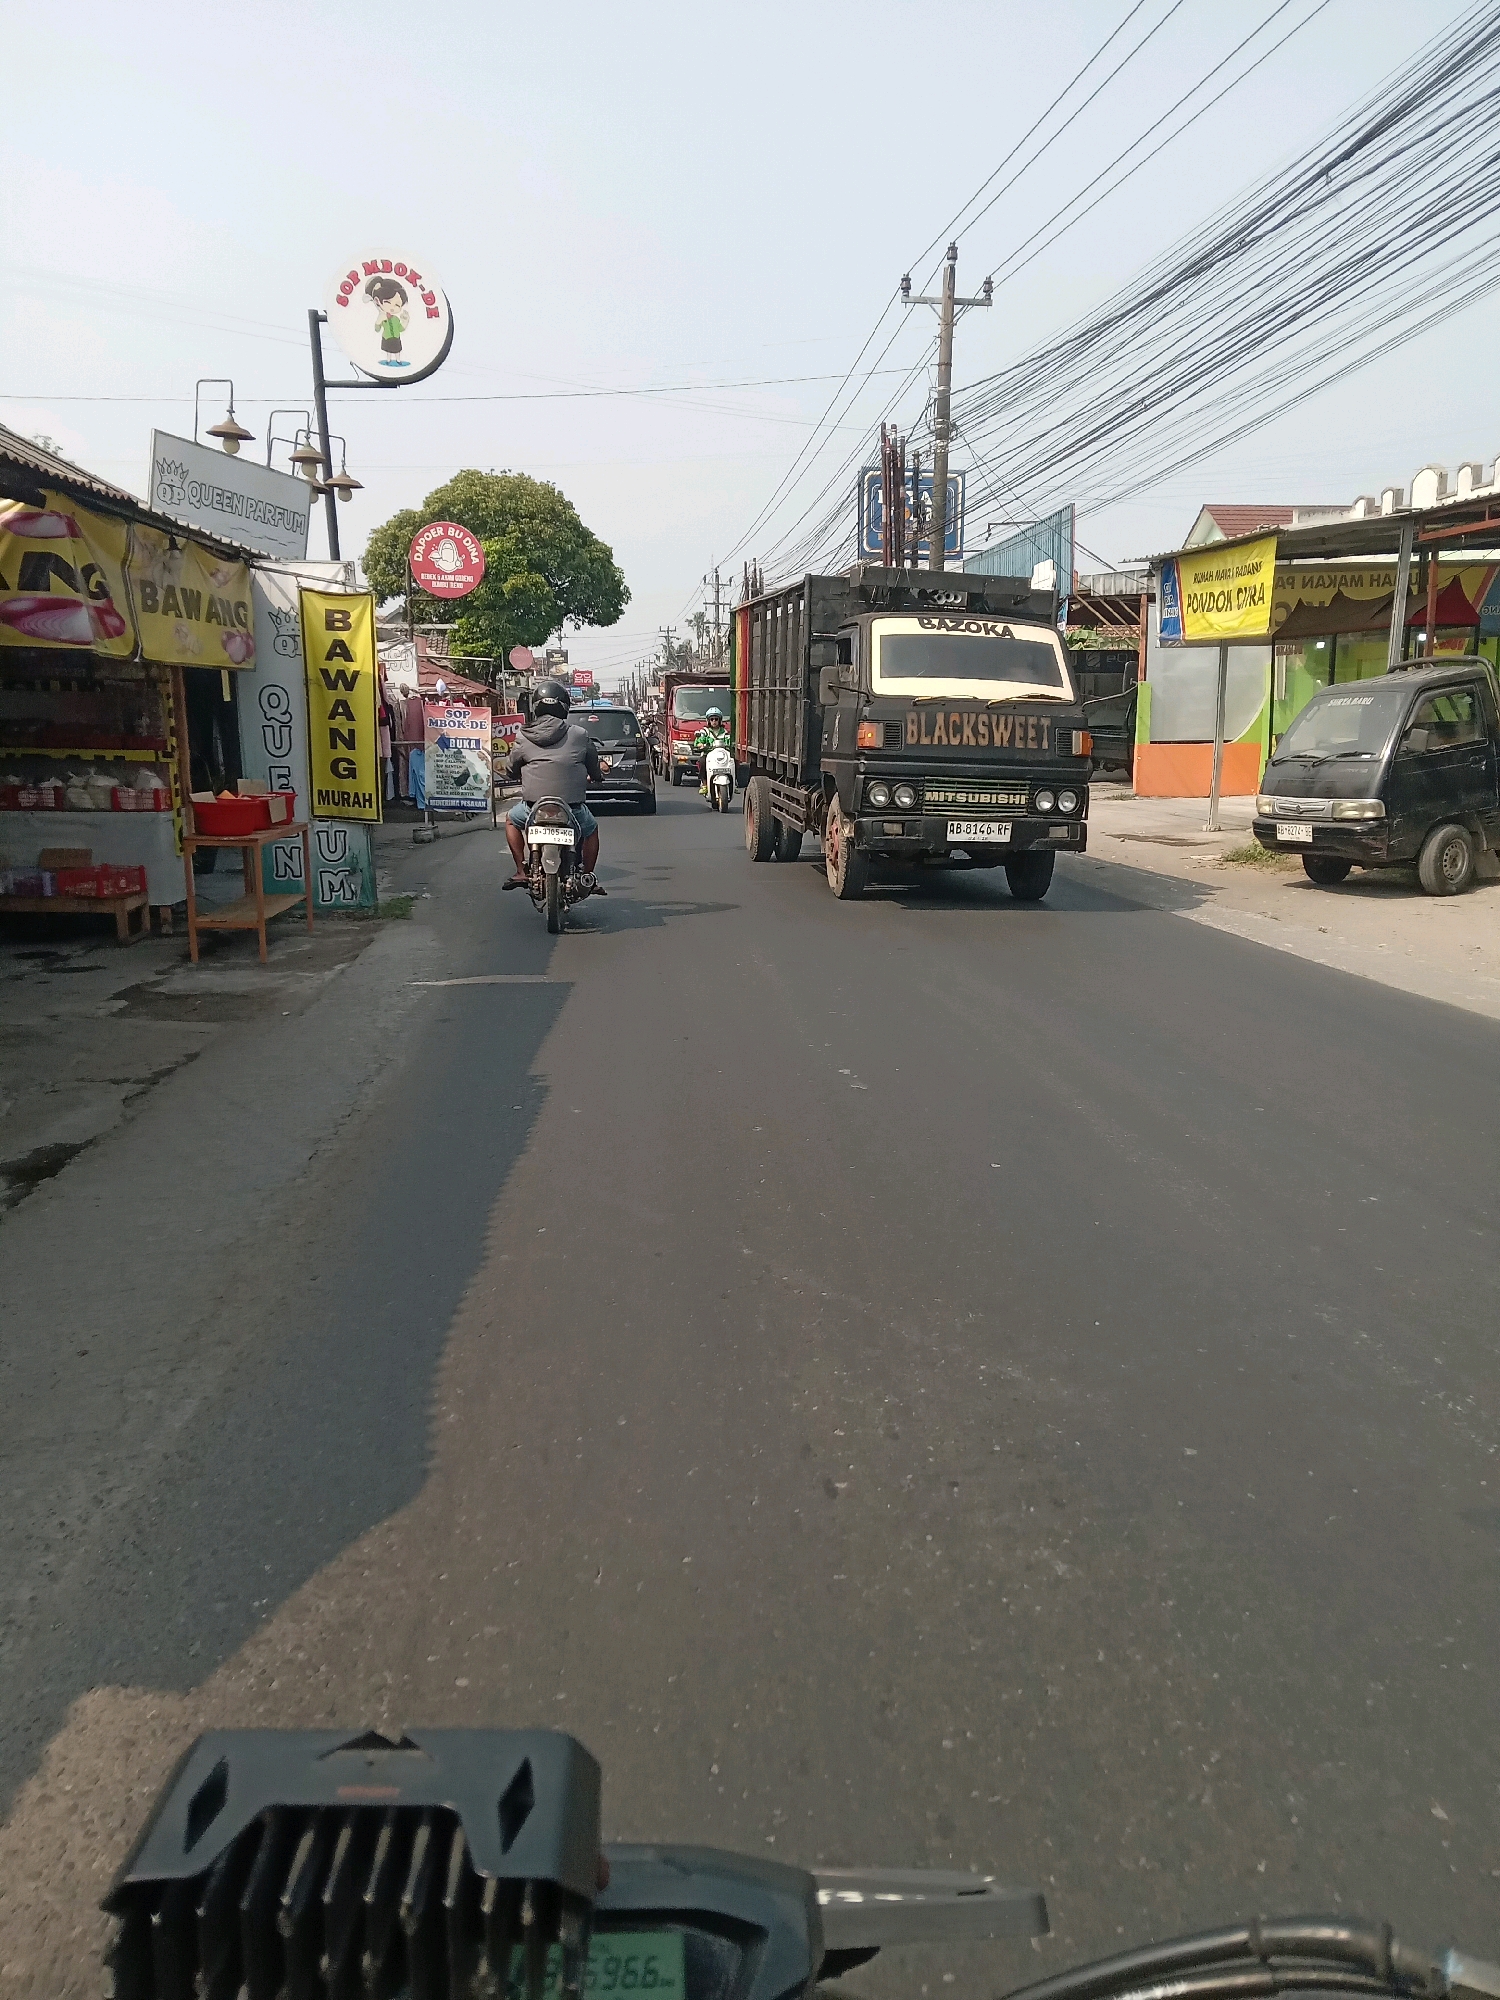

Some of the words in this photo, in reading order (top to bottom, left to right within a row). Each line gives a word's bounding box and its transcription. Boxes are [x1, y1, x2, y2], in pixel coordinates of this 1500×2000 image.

[336, 270, 361, 307] SOP
[362, 259, 440, 319] MBOK-DE
[157, 482, 185, 505] QP
[187, 480, 243, 517] QUEEN
[245, 497, 306, 535] PARFUM
[414, 527, 444, 562] DAPOER
[448, 527, 463, 539] BU
[462, 537, 480, 564] DINA
[139, 579, 248, 629] BAWANG
[917, 617, 1015, 639] BAZOKA
[319, 608, 360, 780] BAWANG
[428, 718, 488, 730] MBOK-DE
[445, 709, 471, 719] SOP
[449, 739, 476, 749] BUKA
[905, 711, 1050, 750] BLACKSWEET
[317, 788, 373, 809] MURAH
[925, 791, 1027, 804] MITSUBISHI
